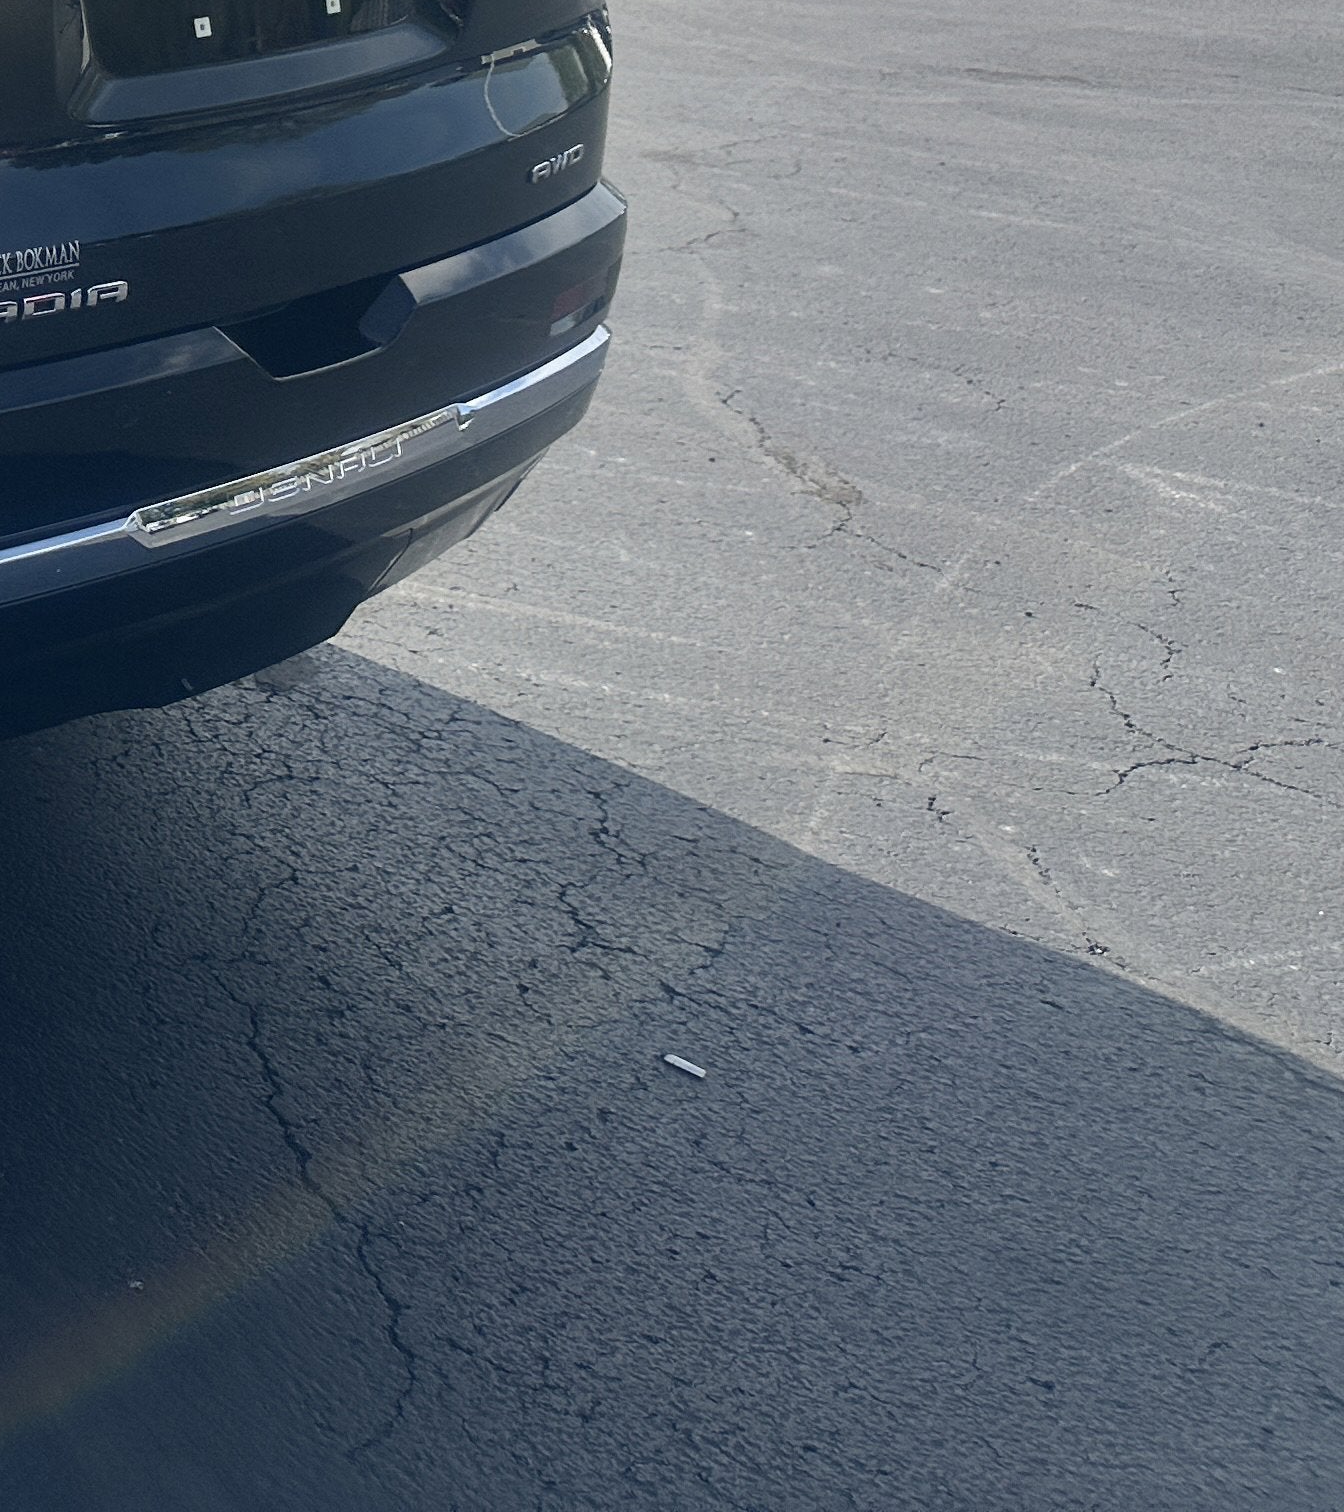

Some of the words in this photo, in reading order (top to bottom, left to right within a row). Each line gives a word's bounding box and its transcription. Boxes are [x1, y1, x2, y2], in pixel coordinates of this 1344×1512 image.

[532, 143, 584, 184] AWD
[15, 240, 80, 273] BOKMAN
[21, 274, 45, 288] NEW
[45, 269, 75, 284] YORK
